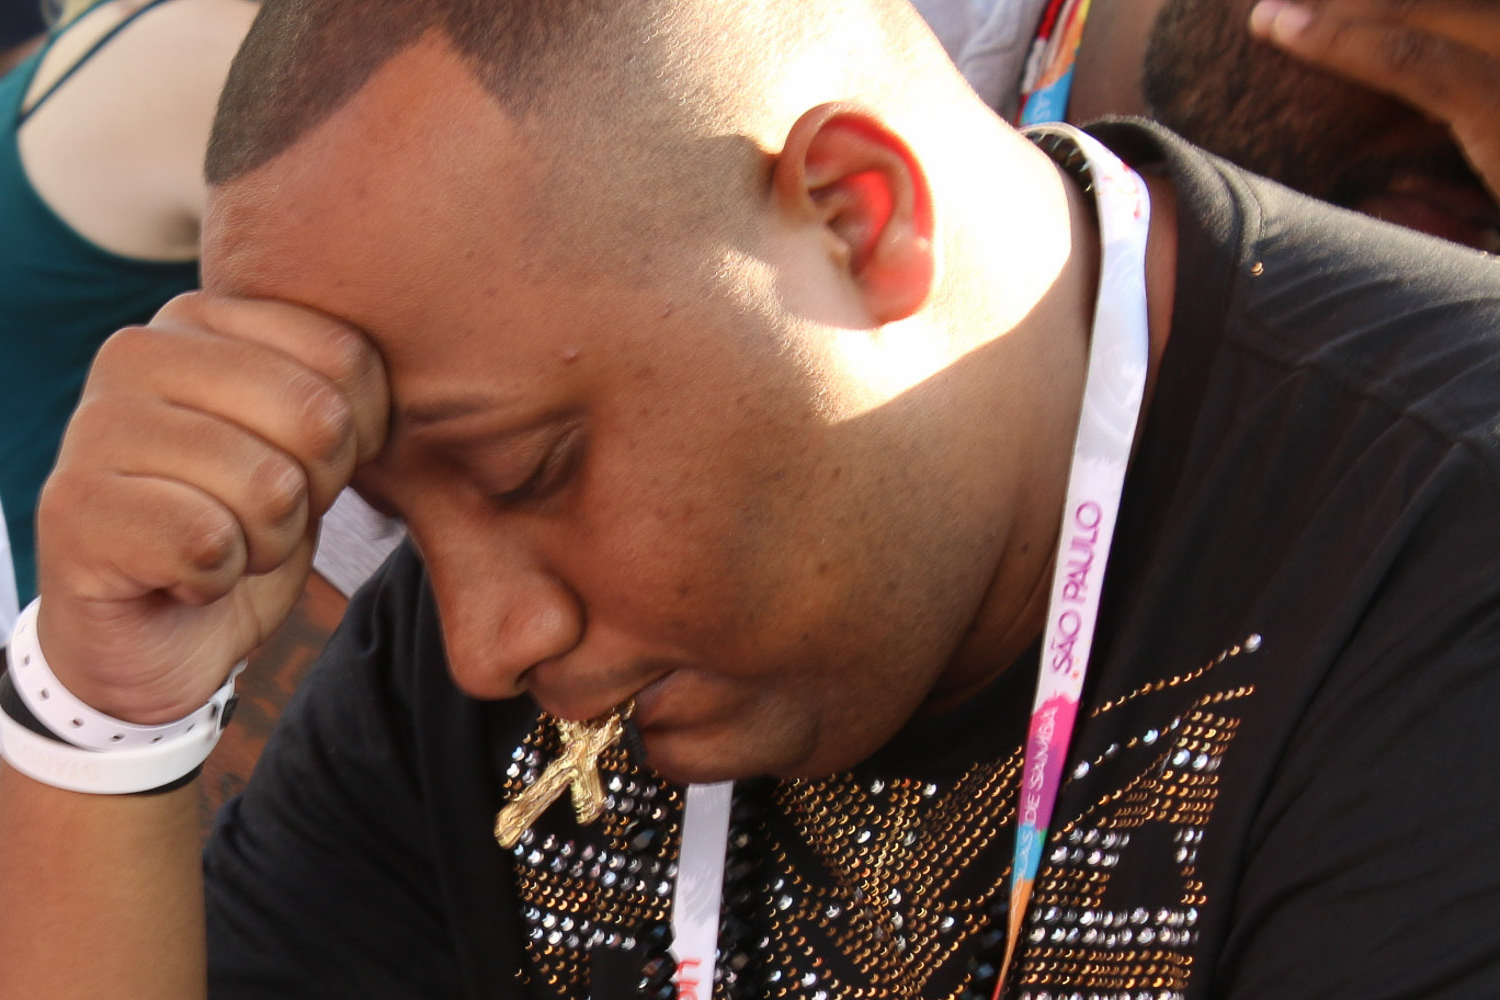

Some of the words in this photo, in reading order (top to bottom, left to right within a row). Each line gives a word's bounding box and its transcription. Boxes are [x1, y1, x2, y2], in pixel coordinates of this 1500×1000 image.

[1063, 502, 1102, 602] PAULO
[1051, 610, 1082, 674] SÃO
[1027, 707, 1057, 791] SAMBA
